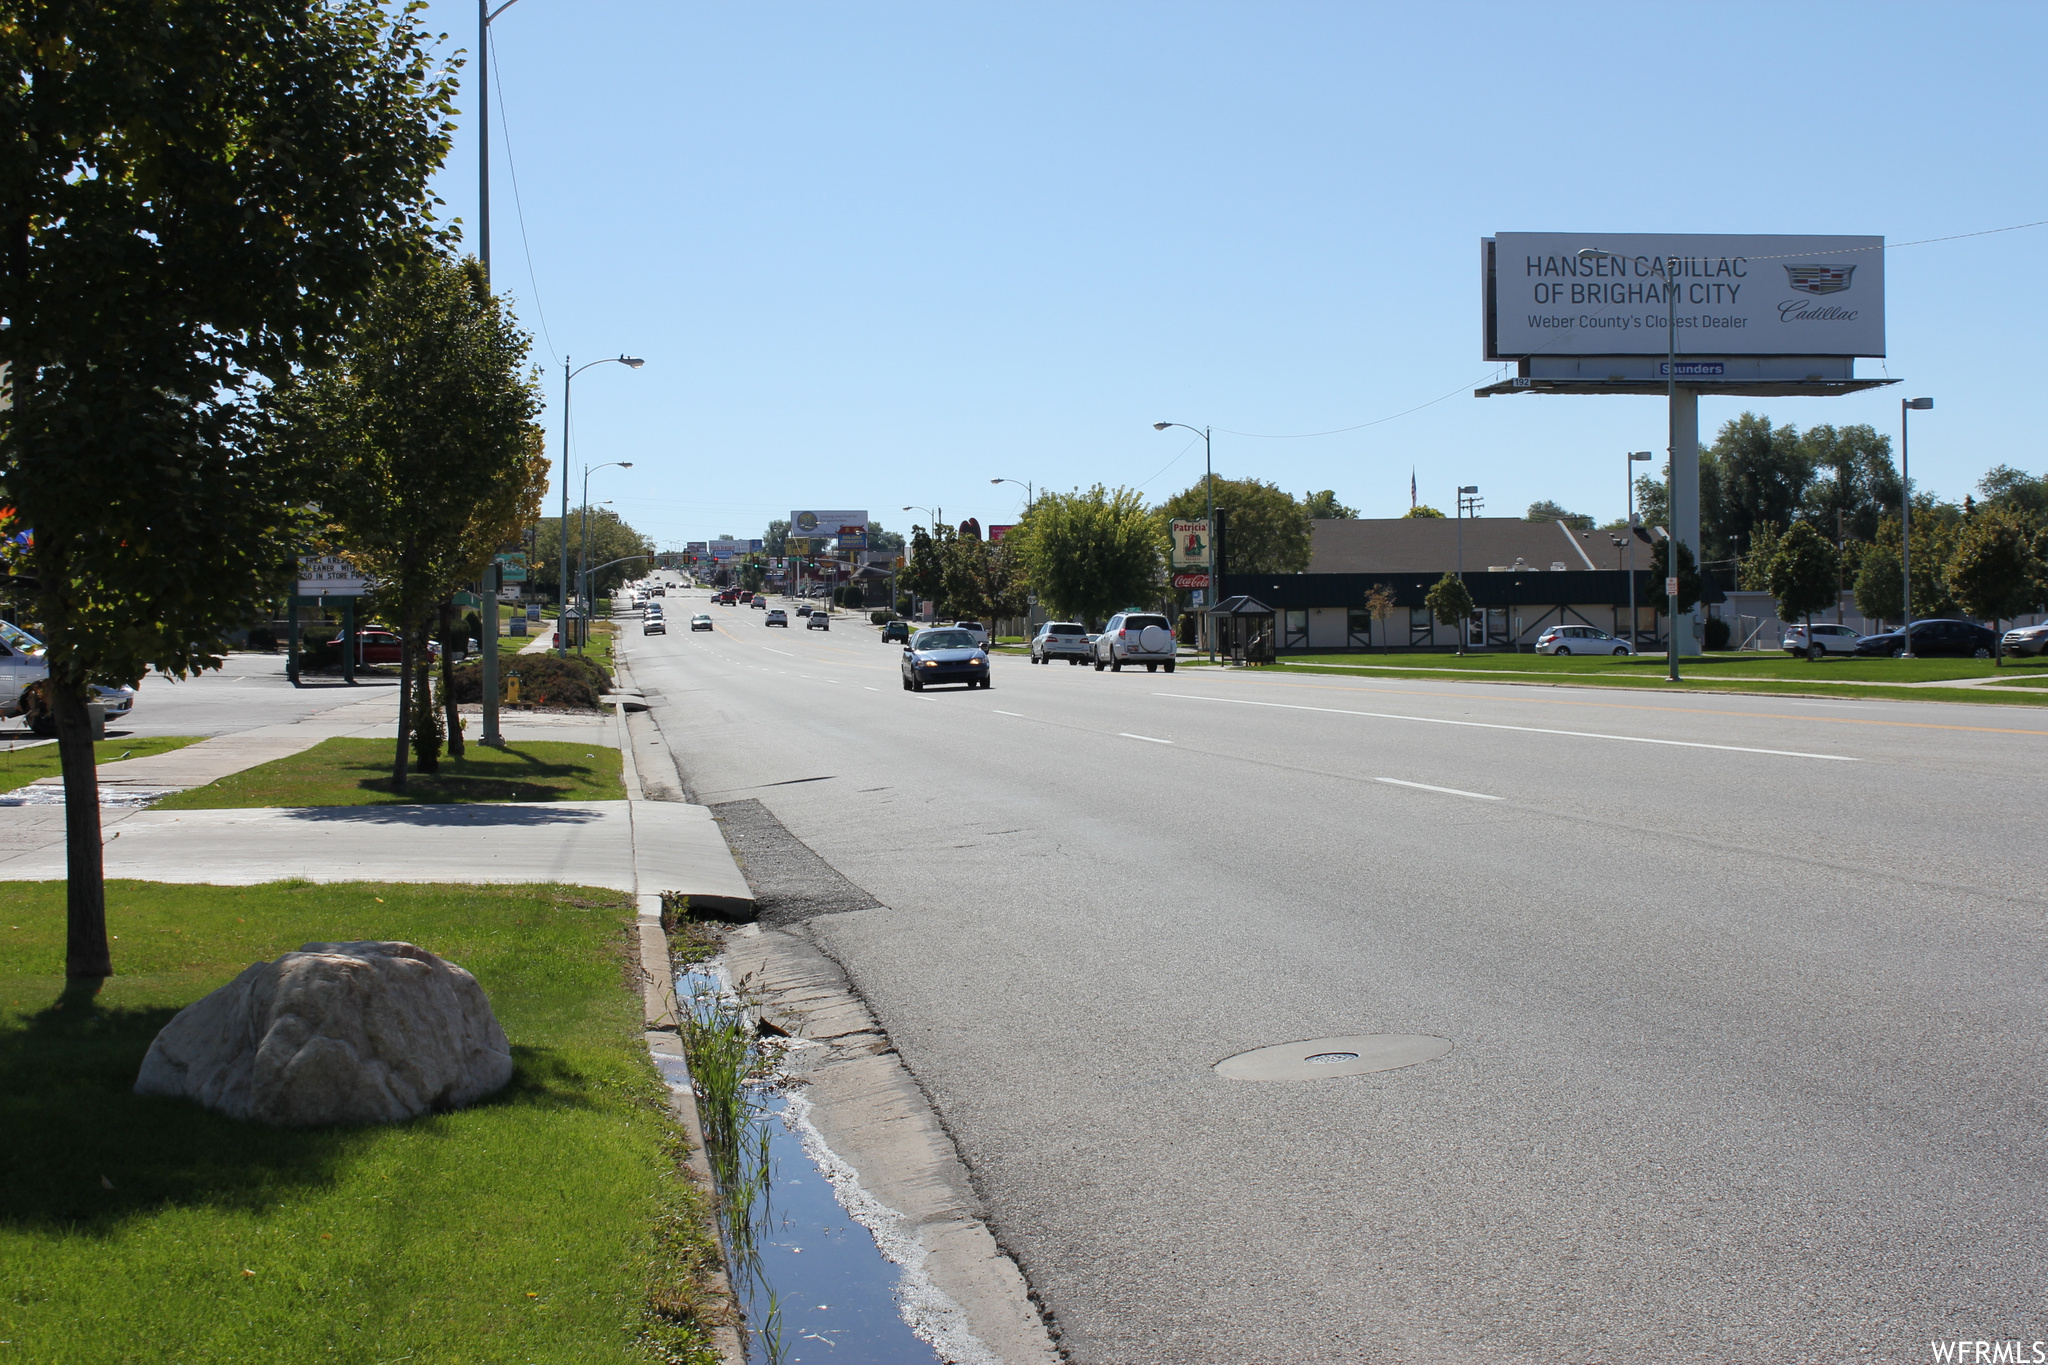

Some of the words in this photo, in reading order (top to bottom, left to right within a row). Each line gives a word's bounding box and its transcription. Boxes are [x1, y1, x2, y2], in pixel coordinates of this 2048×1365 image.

[1526, 256, 1626, 277] HANSEN
[1634, 256, 1748, 278] CADILLAC
[1534, 282, 1564, 304] OF
[1571, 282, 1681, 304] BRIGHAM
[1689, 283, 1741, 305] CITY
[1777, 299, 1859, 323] Cadillac
[1527, 314, 1575, 328] Weber
[1579, 314, 1641, 330] County's
[1645, 314, 1699, 328] Cloest
[1702, 314, 1748, 328] Dealer
[1514, 378, 1529, 386] 192
[1173, 523, 1208, 532] Patricia'
[327, 572, 348, 580] STORE
[1174, 574, 1210, 588] Coca-Cola
